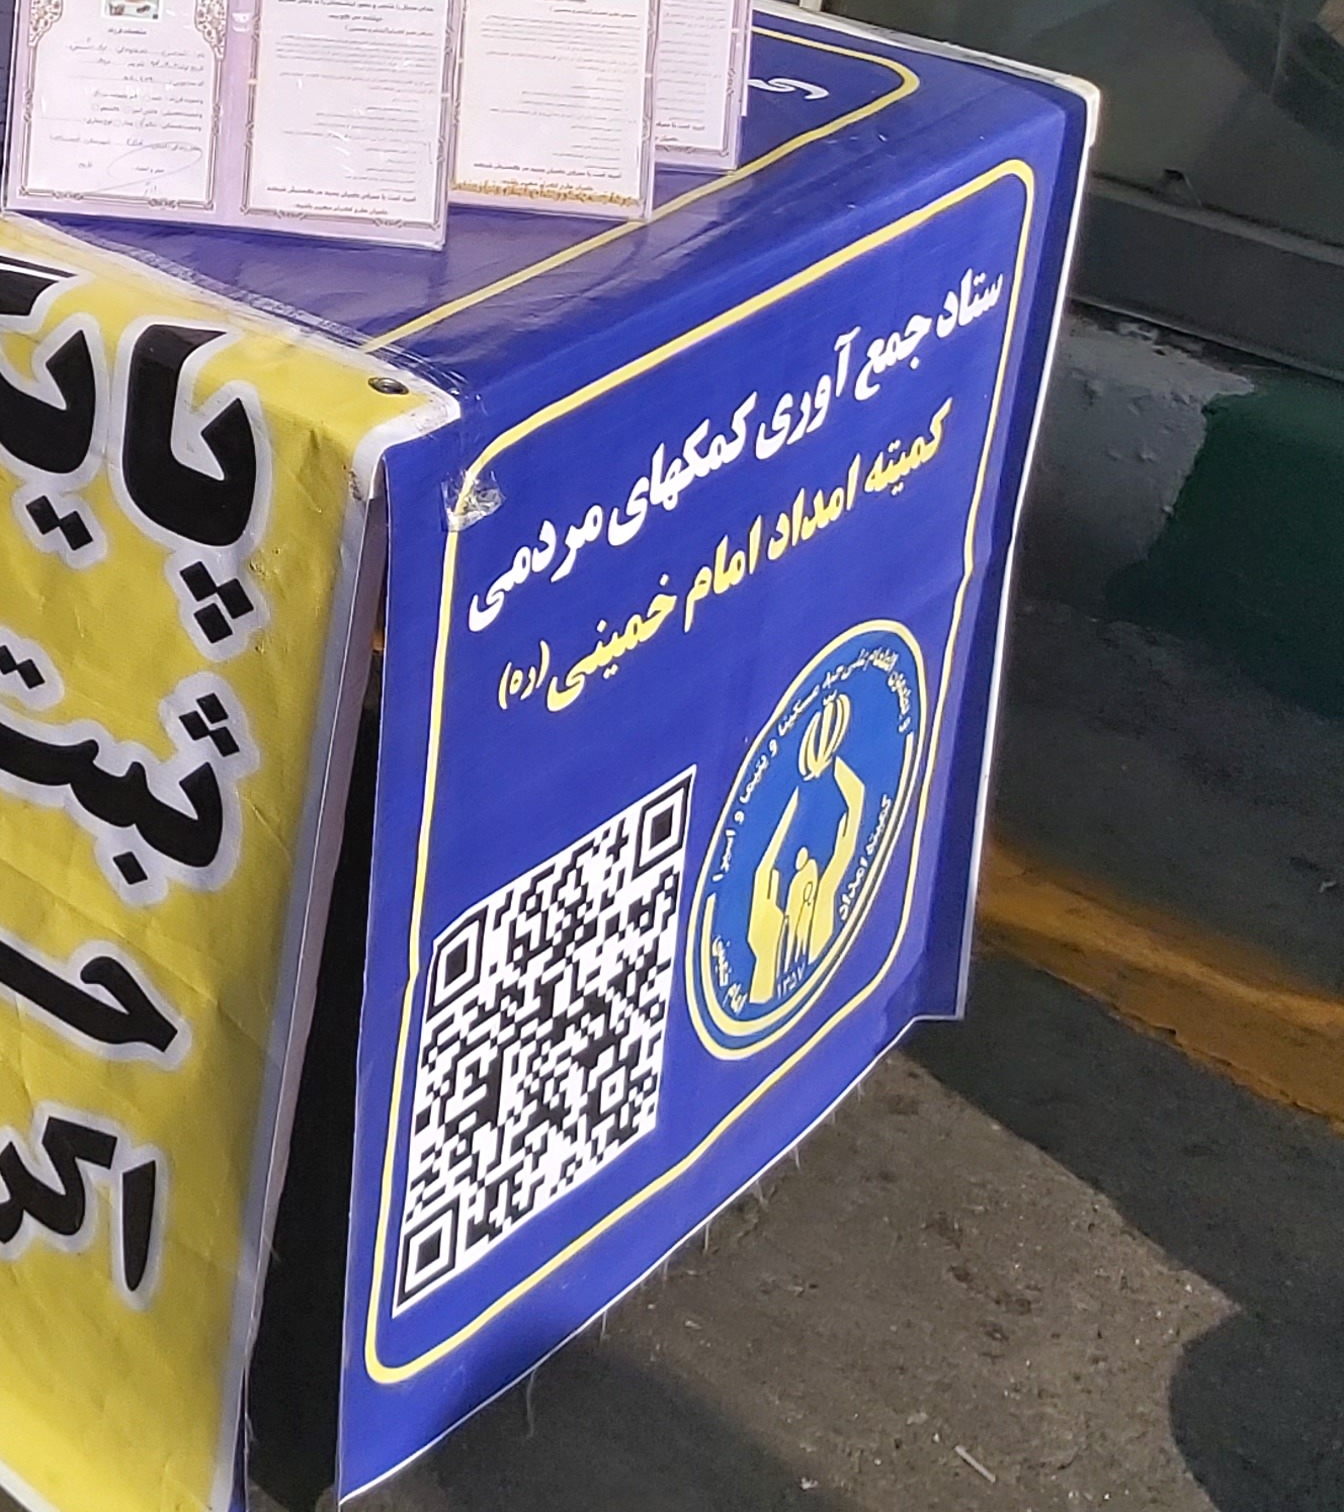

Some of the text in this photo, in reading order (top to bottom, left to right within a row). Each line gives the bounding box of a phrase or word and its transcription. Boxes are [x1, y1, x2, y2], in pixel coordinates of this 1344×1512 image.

[467, 265, 1003, 632] ستاد جمع آوری کمکهای مردمی
[864, 397, 953, 496] کمیته
[767, 453, 857, 564] امداد
[683, 514, 764, 633] امام
[545, 569, 681, 714] خمینی
